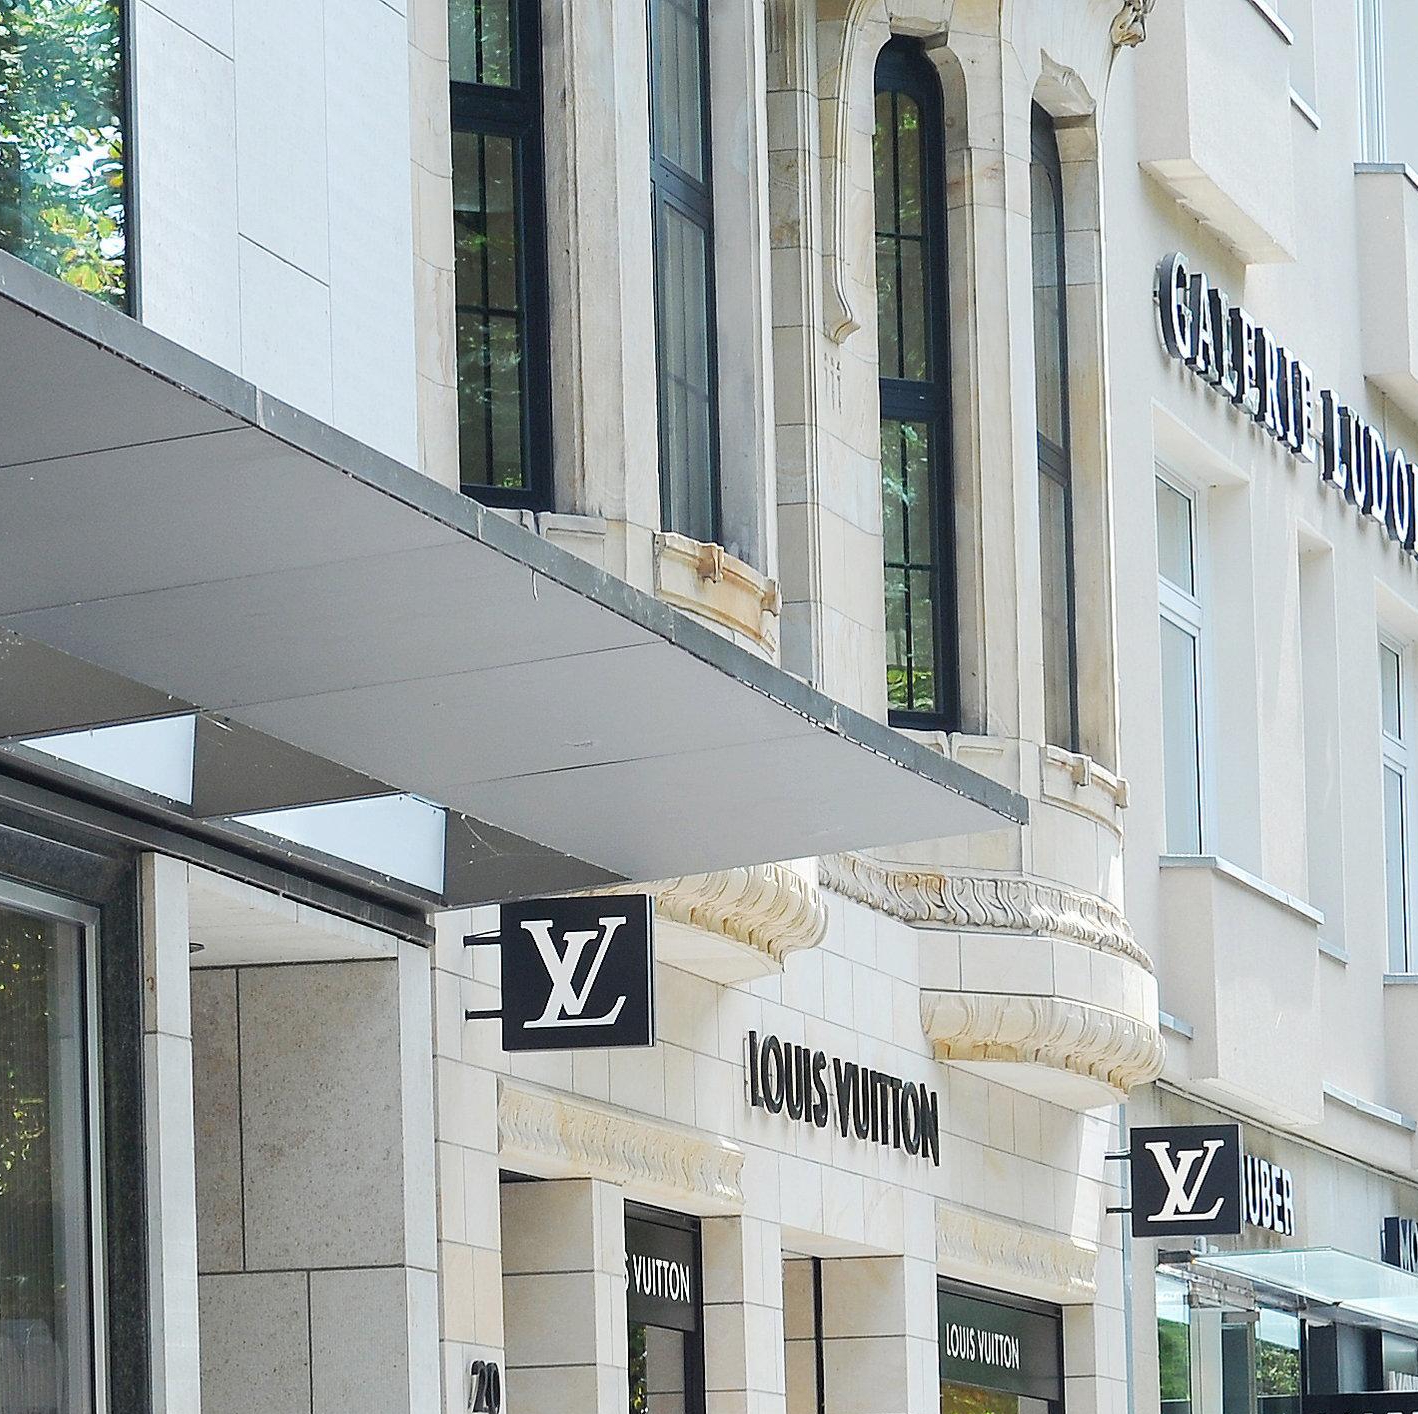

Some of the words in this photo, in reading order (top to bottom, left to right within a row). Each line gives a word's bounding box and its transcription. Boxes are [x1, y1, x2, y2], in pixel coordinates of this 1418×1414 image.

[1153, 251, 1318, 464] GALERIE
[520, 916, 627, 1029] LV
[748, 1030, 829, 1128] LOUIS
[833, 1057, 940, 1167] VUITTON
[1144, 1139, 1225, 1222] LV
[1243, 1154, 1296, 1237] UBER
[632, 1253, 691, 1304] VUITTON
[946, 1322, 976, 1362] LOUIS
[977, 1329, 1020, 1370] VUITTON
